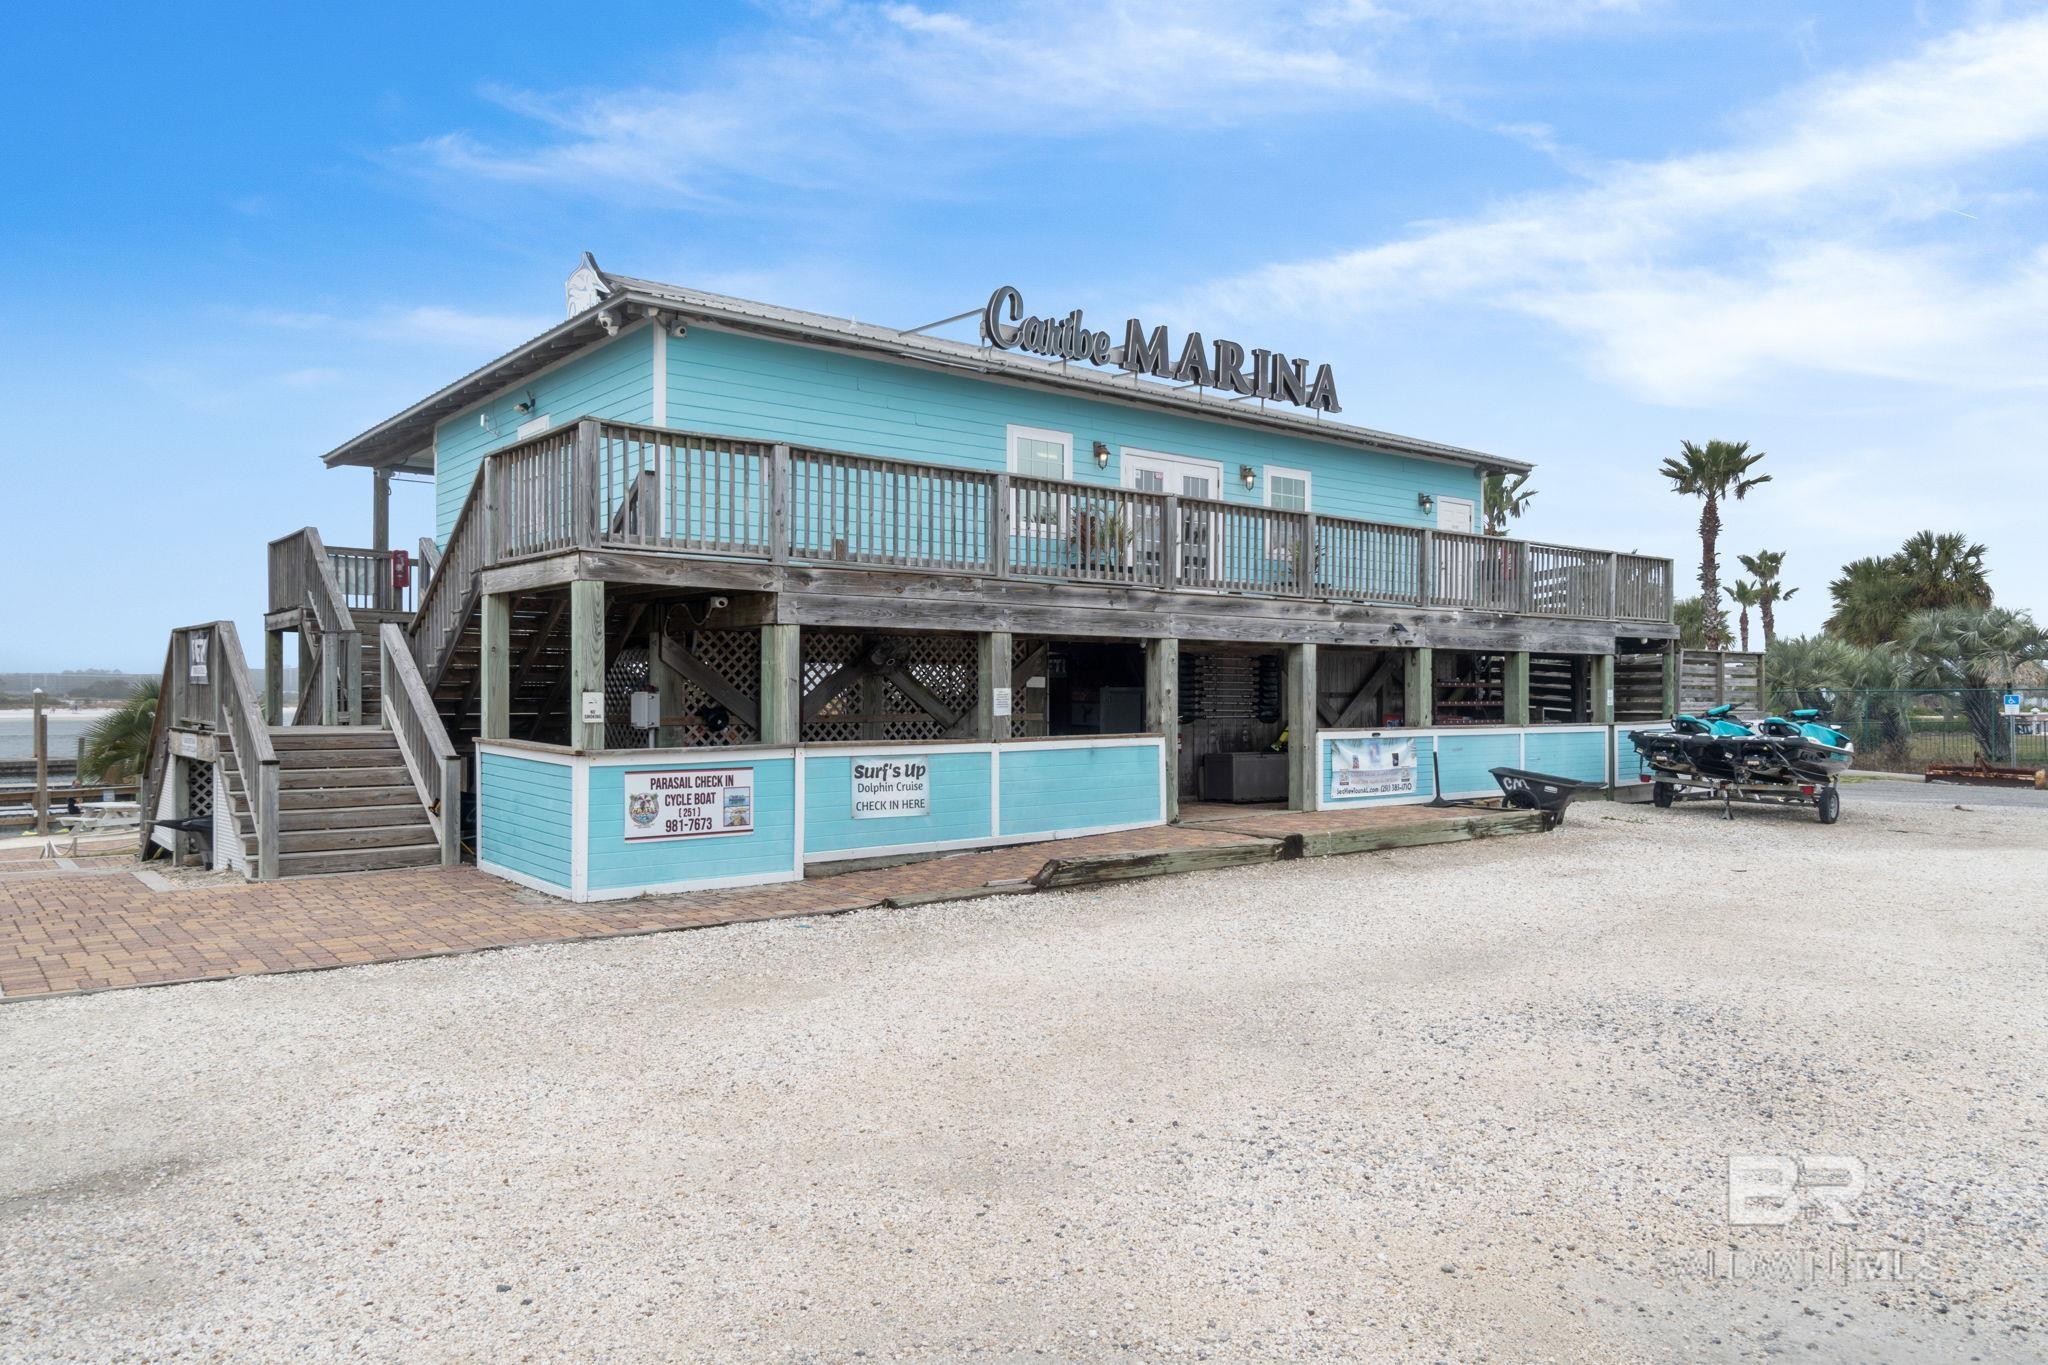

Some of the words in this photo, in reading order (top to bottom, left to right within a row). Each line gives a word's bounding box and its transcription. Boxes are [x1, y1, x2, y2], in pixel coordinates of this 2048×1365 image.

[984, 285, 1111, 366] Caribe
[1118, 318, 1342, 414] MARINA
[854, 763, 901, 781] Surf's
[904, 763, 926, 780] Up
[650, 776, 693, 790] PARASAIL
[695, 775, 723, 788] CHECK
[725, 774, 734, 787] IN
[857, 782, 894, 795] Dolphin
[896, 781, 924, 792] Cruise
[1502, 777, 1530, 790] CM
[664, 793, 692, 807] CYCLE
[694, 792, 716, 805] BOAT
[856, 800, 887, 811] CHECK
[889, 800, 899, 810] IN
[902, 798, 926, 809] HERE
[665, 817, 713, 832] 981-7673
